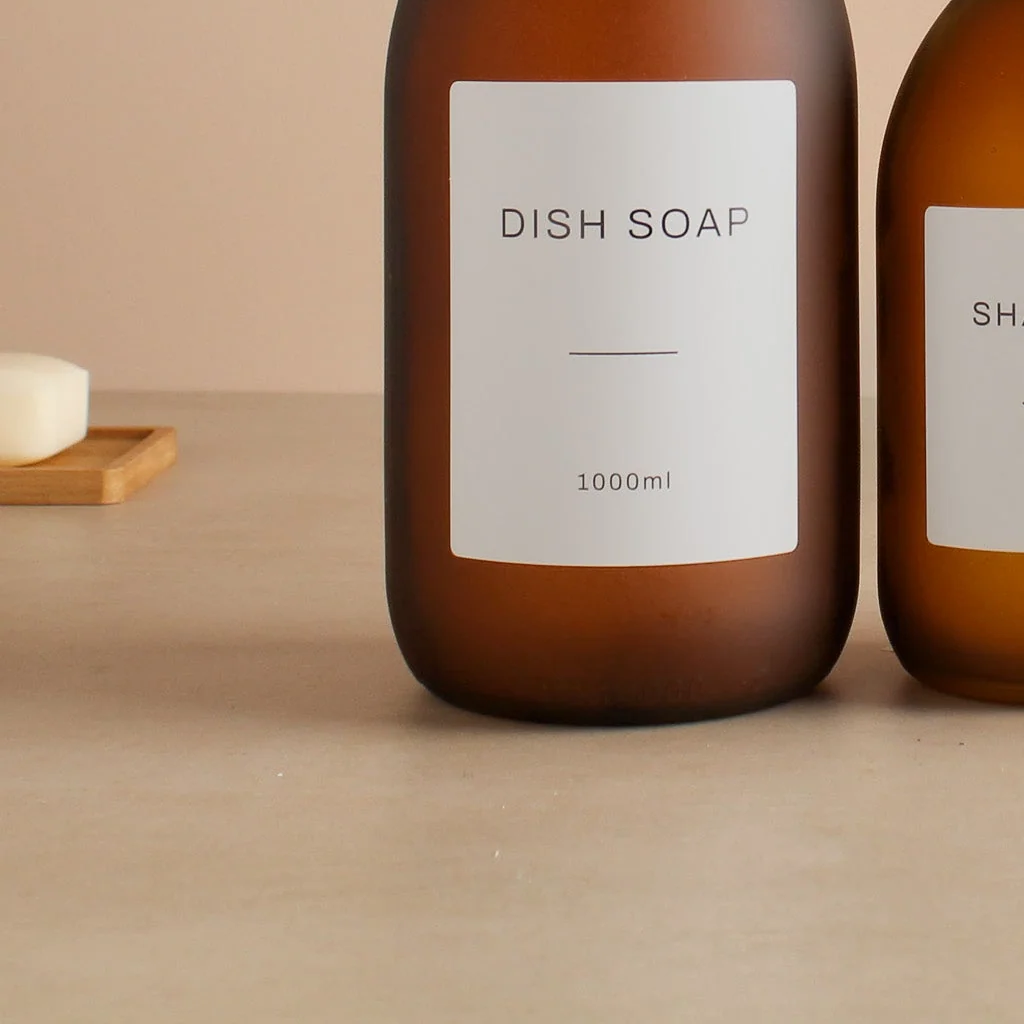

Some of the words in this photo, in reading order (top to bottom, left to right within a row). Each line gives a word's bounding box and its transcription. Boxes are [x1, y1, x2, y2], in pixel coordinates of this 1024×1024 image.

[501, 207, 605, 240] DISH
[628, 207, 750, 240] SOAP
[577, 470, 671, 492] 1000ml
